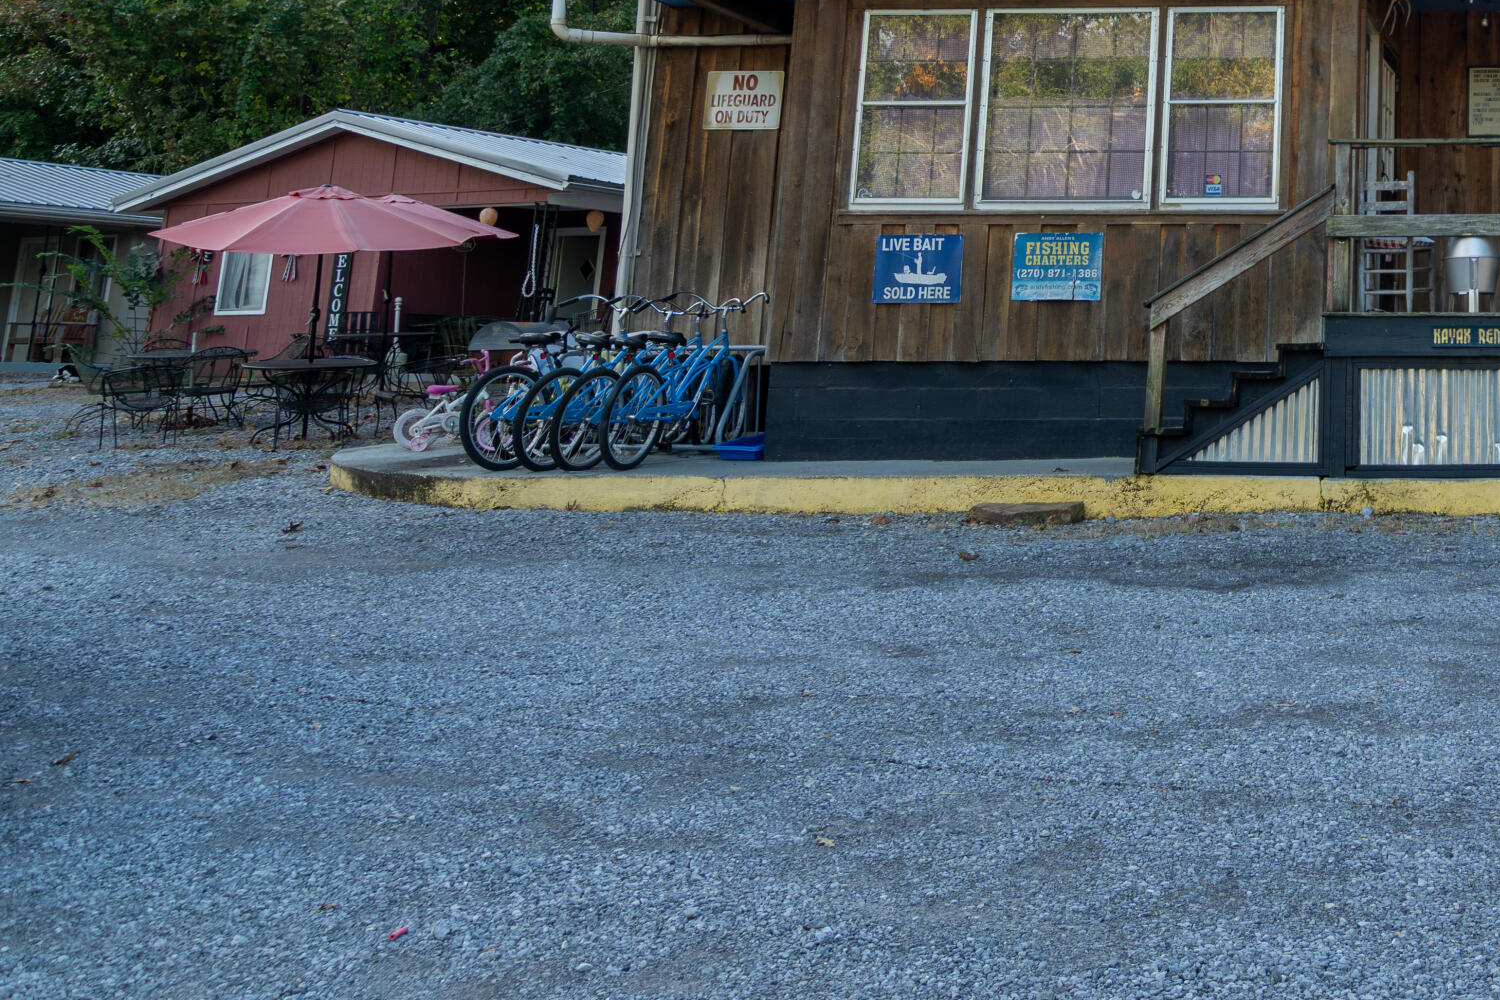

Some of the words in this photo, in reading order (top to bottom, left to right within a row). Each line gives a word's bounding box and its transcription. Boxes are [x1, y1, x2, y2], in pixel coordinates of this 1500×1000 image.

[732, 73, 759, 91] NO
[710, 94, 777, 107] LIFEGUARD
[714, 110, 733, 124] ON
[736, 110, 769, 124] DUTY
[882, 238, 911, 251] LIVE
[913, 238, 945, 251] BAIT
[1025, 241, 1090, 255] FISHING
[1025, 255, 1090, 266] CHARTERS
[1016, 268, 1045, 279] (270)
[327, 254, 348, 342] ELCOME
[883, 286, 915, 300] SOLD
[918, 286, 952, 299] HERE
[1433, 328, 1472, 344] KAYAK
